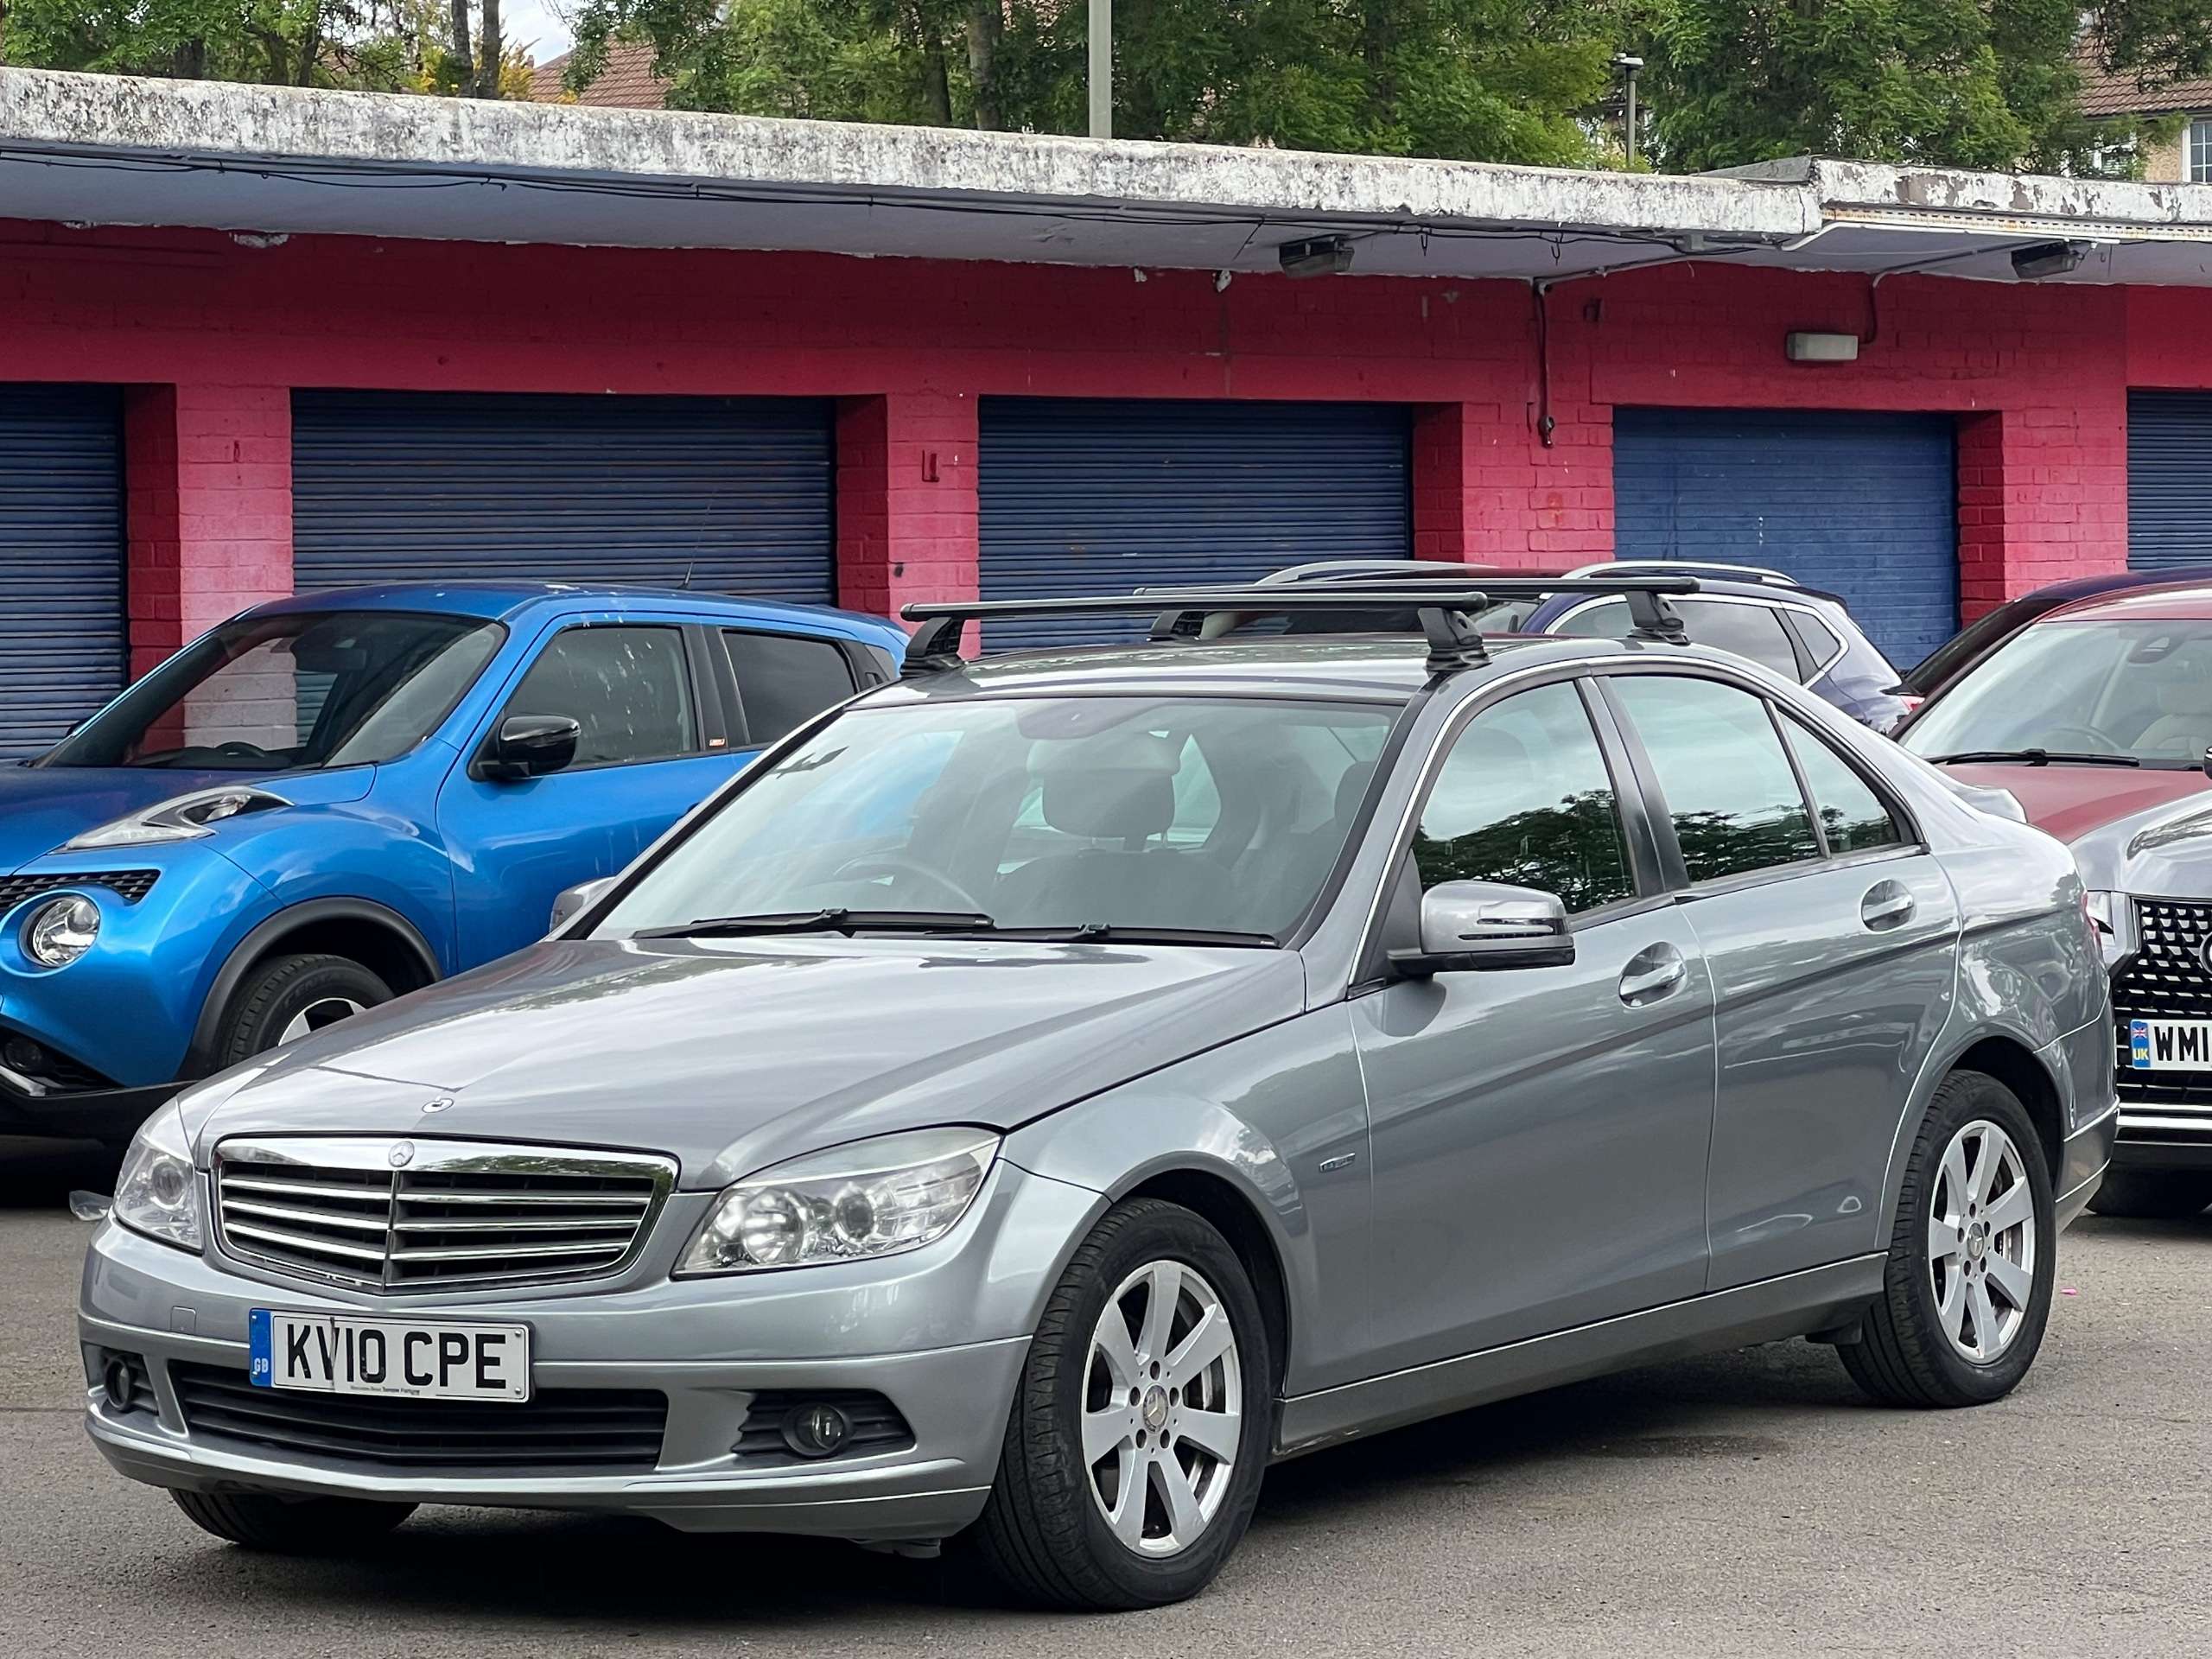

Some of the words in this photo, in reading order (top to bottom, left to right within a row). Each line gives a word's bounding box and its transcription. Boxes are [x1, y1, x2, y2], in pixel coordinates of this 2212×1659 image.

[2133, 1048, 2149, 1060] UK
[288, 1324, 386, 1383] KV10
[404, 1332, 506, 1389] CPE
[254, 1357, 269, 1373] GB
